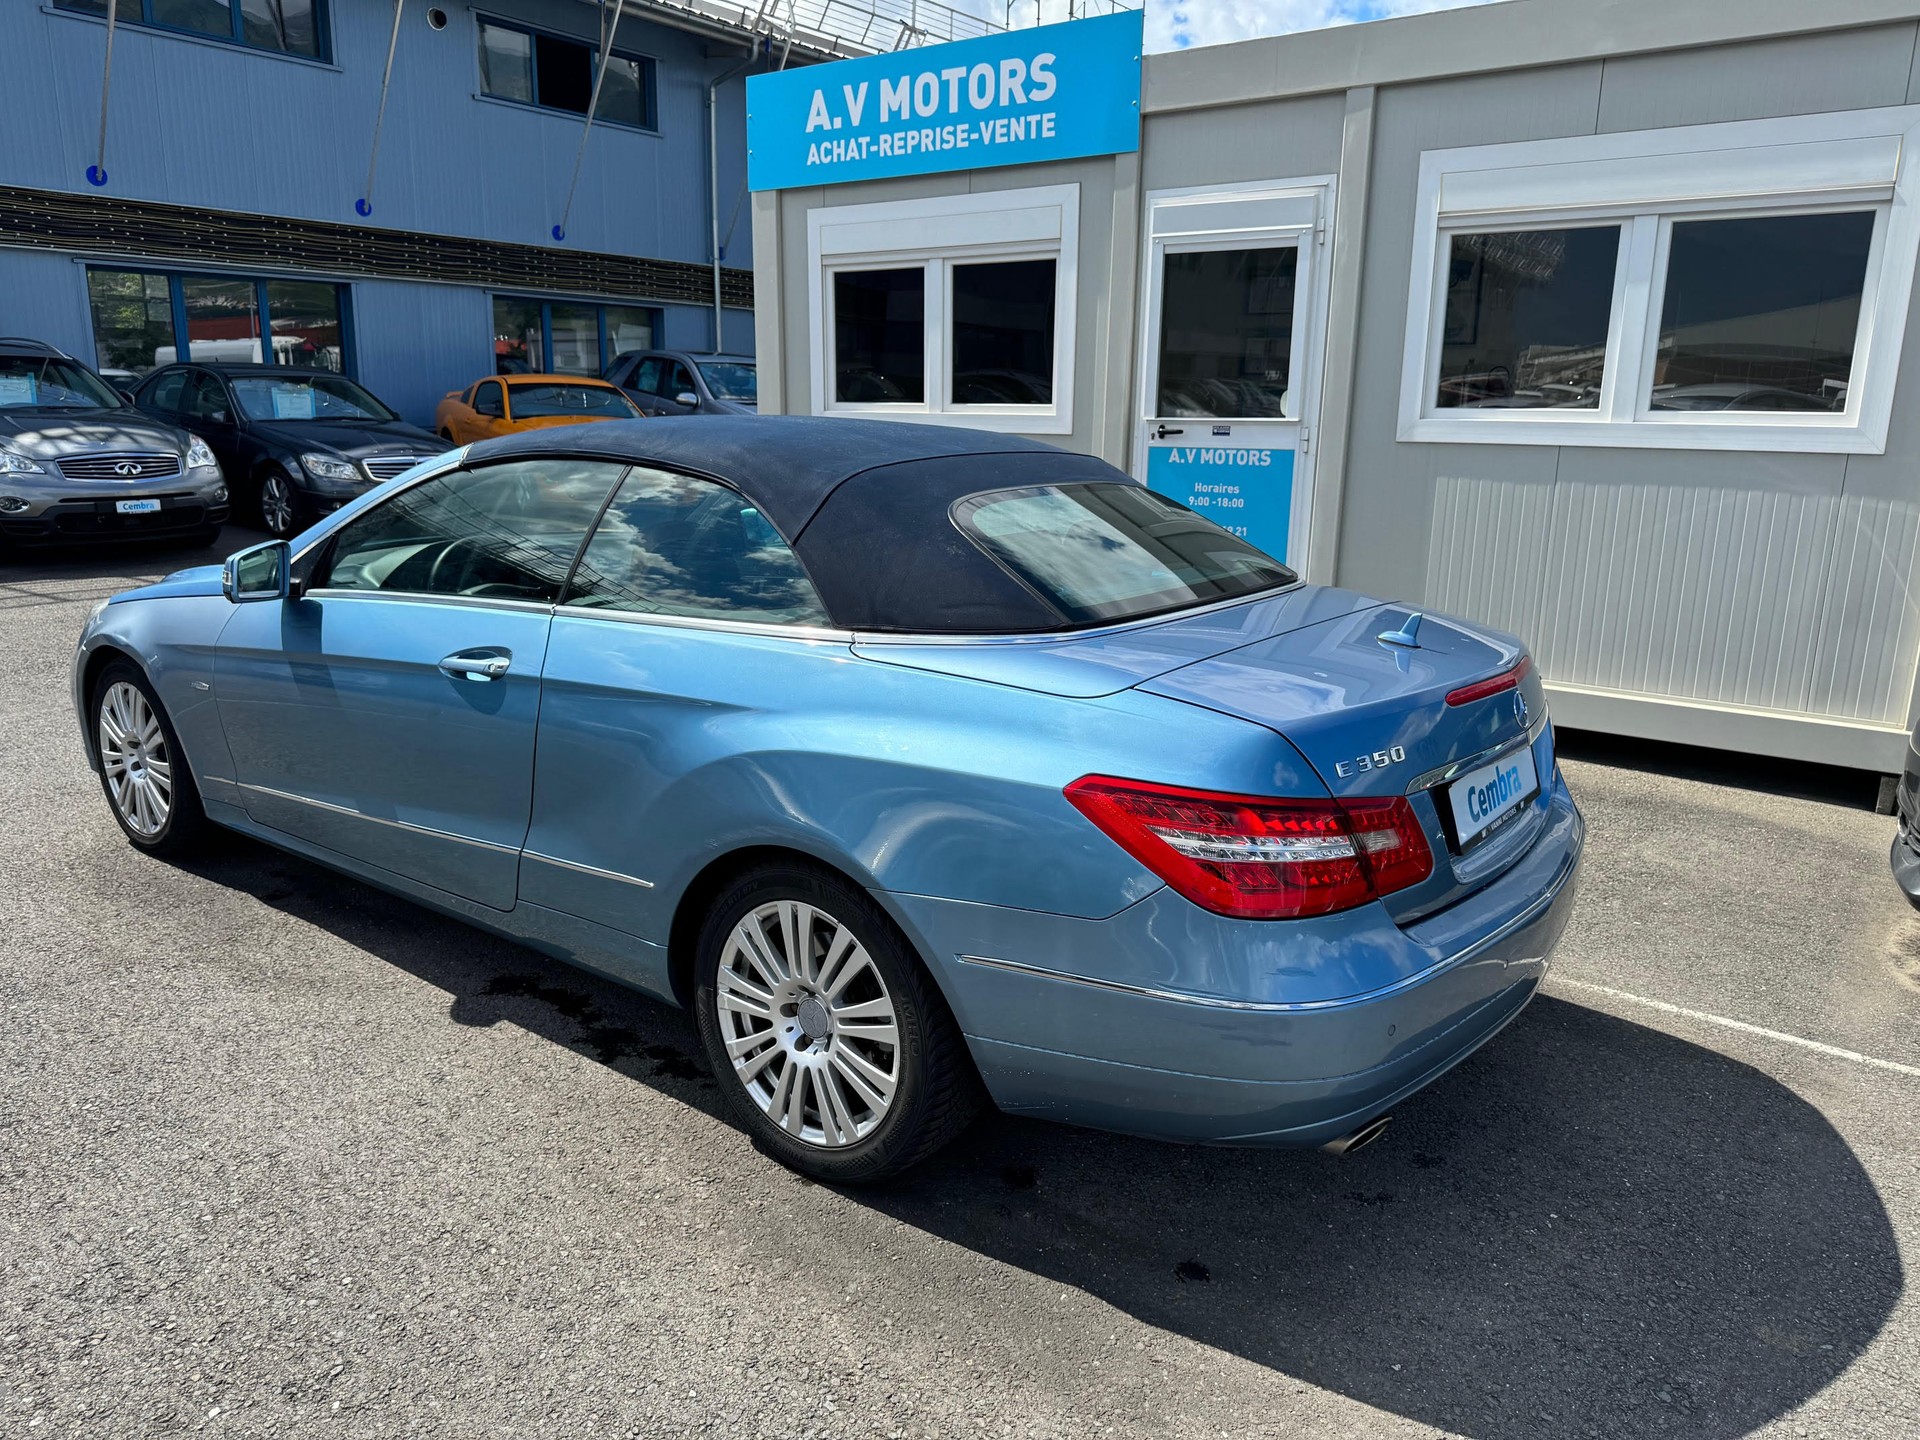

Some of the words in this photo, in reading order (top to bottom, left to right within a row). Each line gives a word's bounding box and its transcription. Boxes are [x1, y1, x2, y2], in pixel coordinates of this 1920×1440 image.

[805, 82, 868, 133] A.V
[880, 53, 1057, 123] MOTORS
[806, 113, 1056, 166] ACHAT-REPRISE-VENTE
[1168, 448, 1196, 463] A.V
[1200, 450, 1271, 466] MOTORS
[1188, 496, 1210, 506] 9:00
[1194, 482, 1240, 494] Horaires
[122, 501, 154, 511] Cembra
[1335, 760, 1351, 779] E
[1356, 745, 1406, 774] 350
[1467, 765, 1523, 823] Cembra
